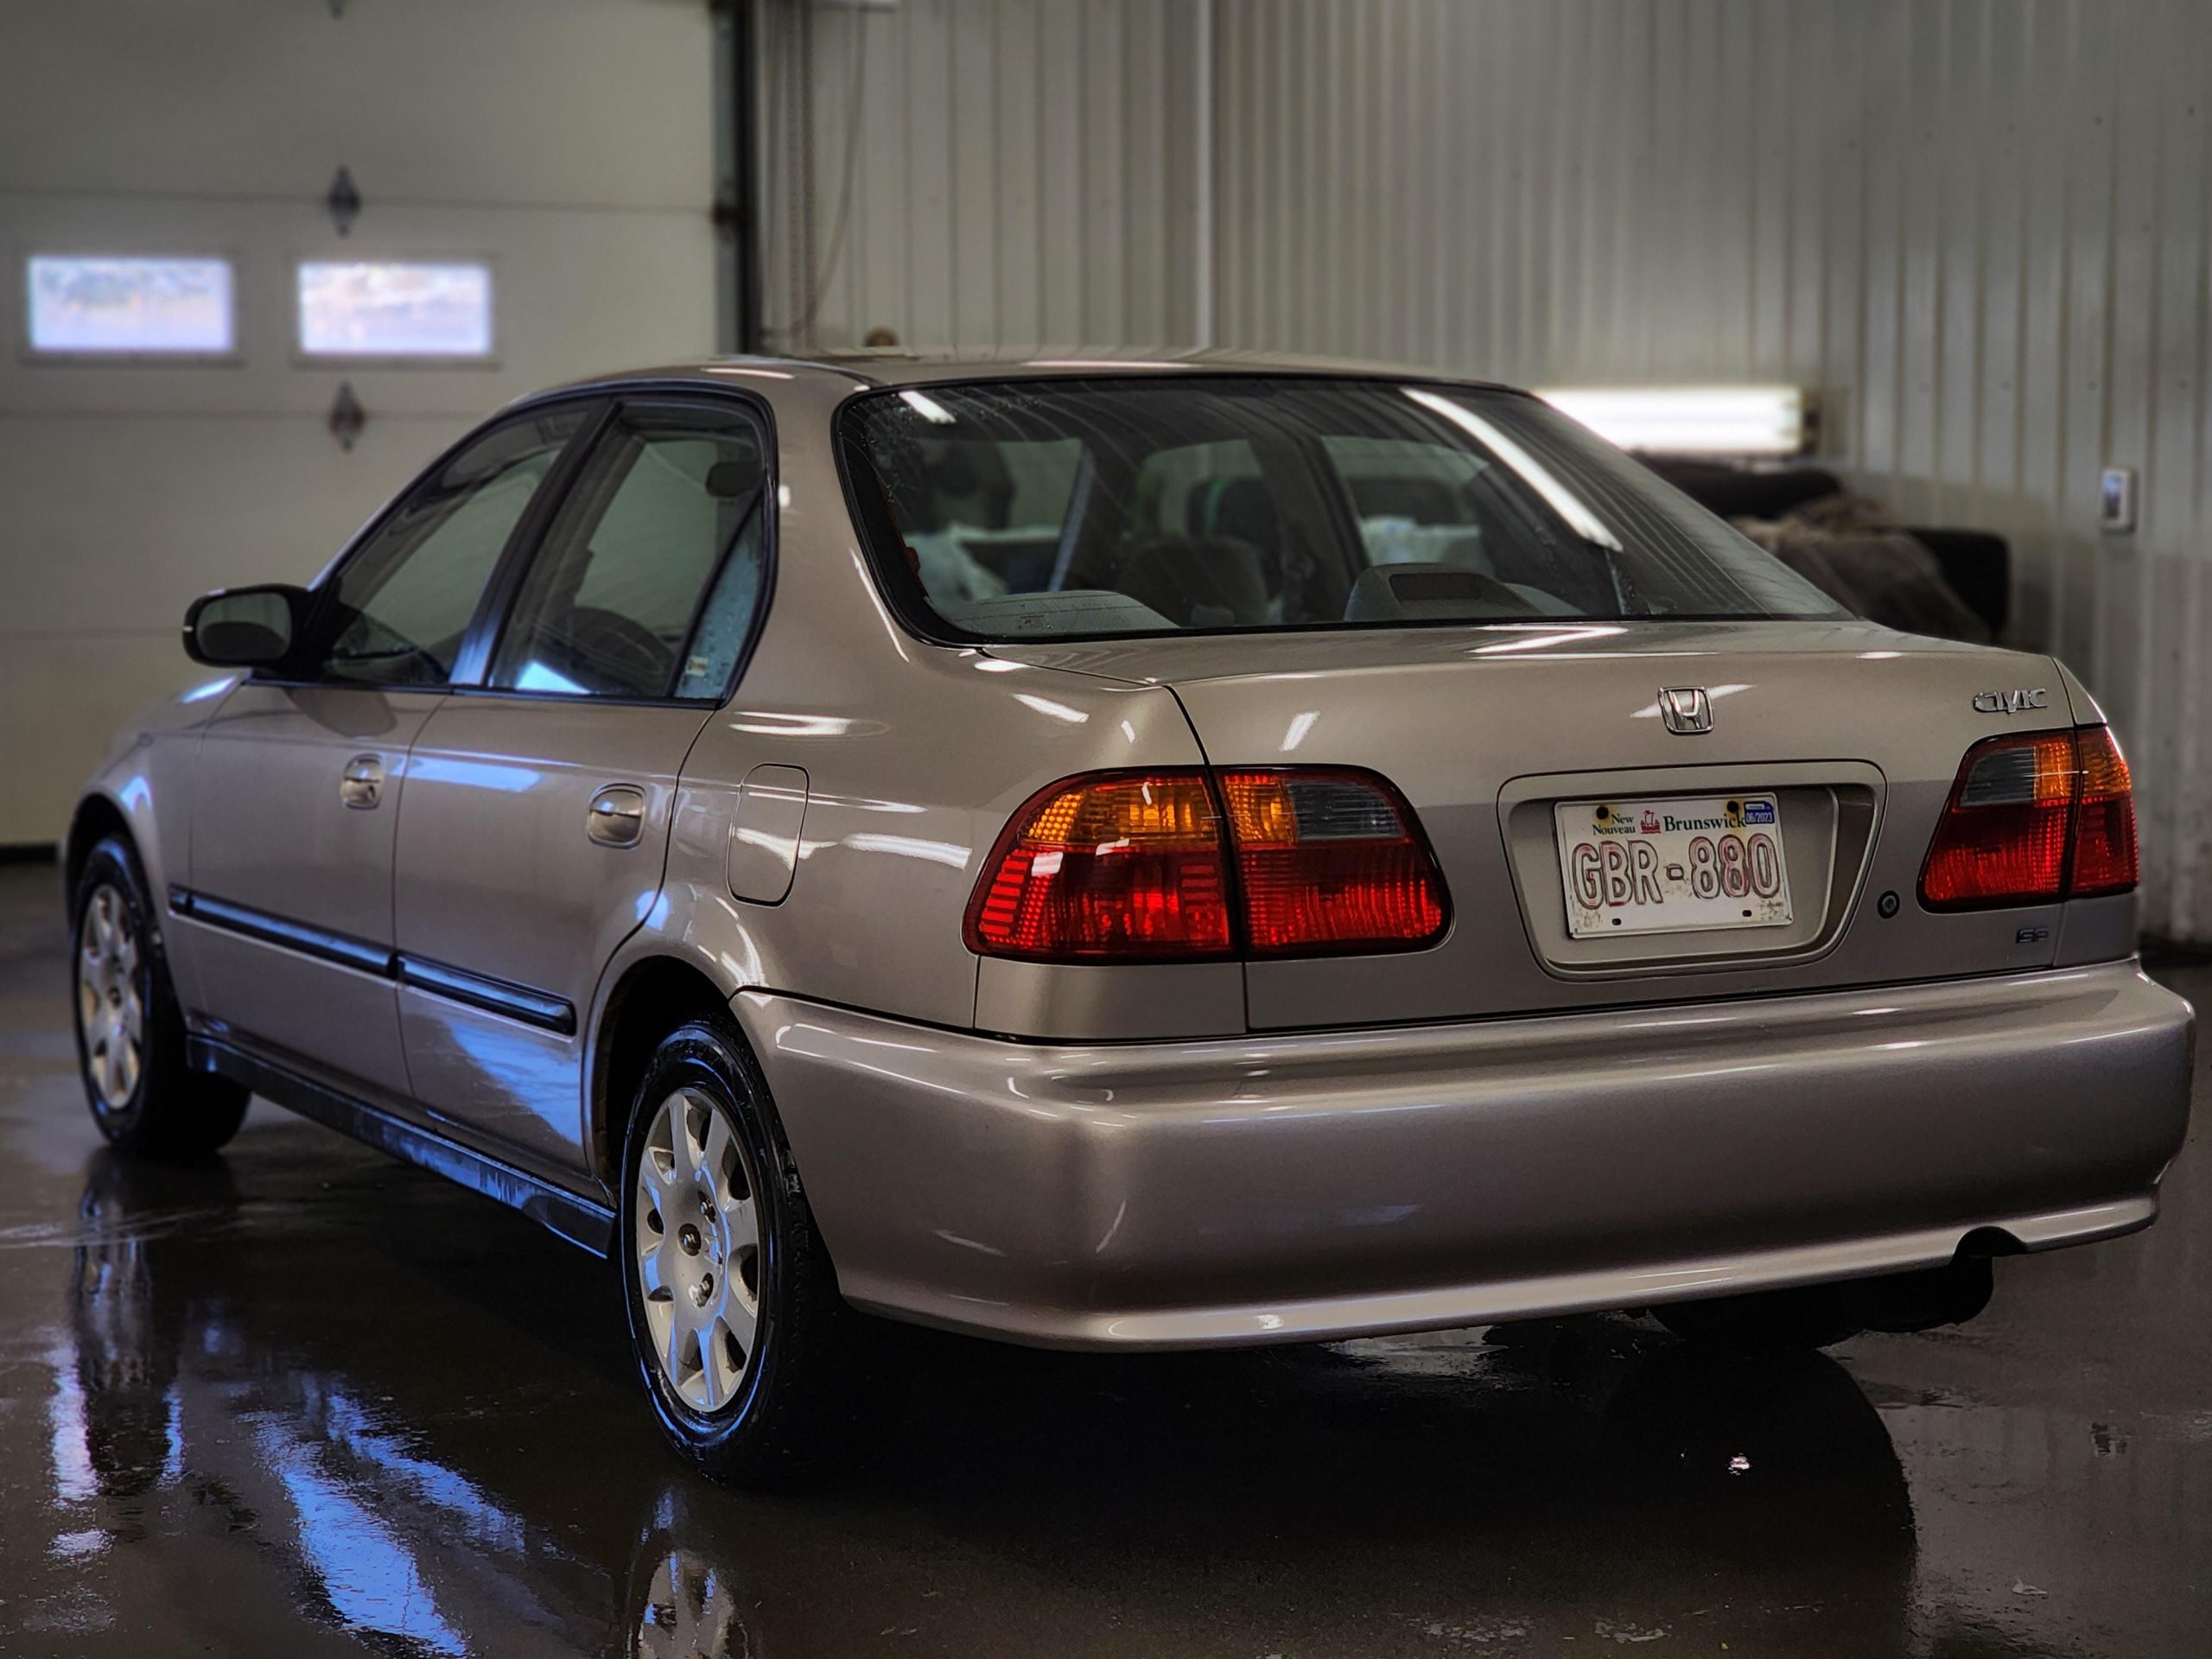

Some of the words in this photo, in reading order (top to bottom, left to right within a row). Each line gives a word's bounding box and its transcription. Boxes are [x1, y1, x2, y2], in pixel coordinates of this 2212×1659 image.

[1974, 689, 2047, 714] CIVIC
[1592, 823, 1636, 836] Nouveau
[1611, 814, 1635, 824] New
[1663, 811, 1746, 832] Brunswick
[1572, 833, 1780, 909] GBR-880
